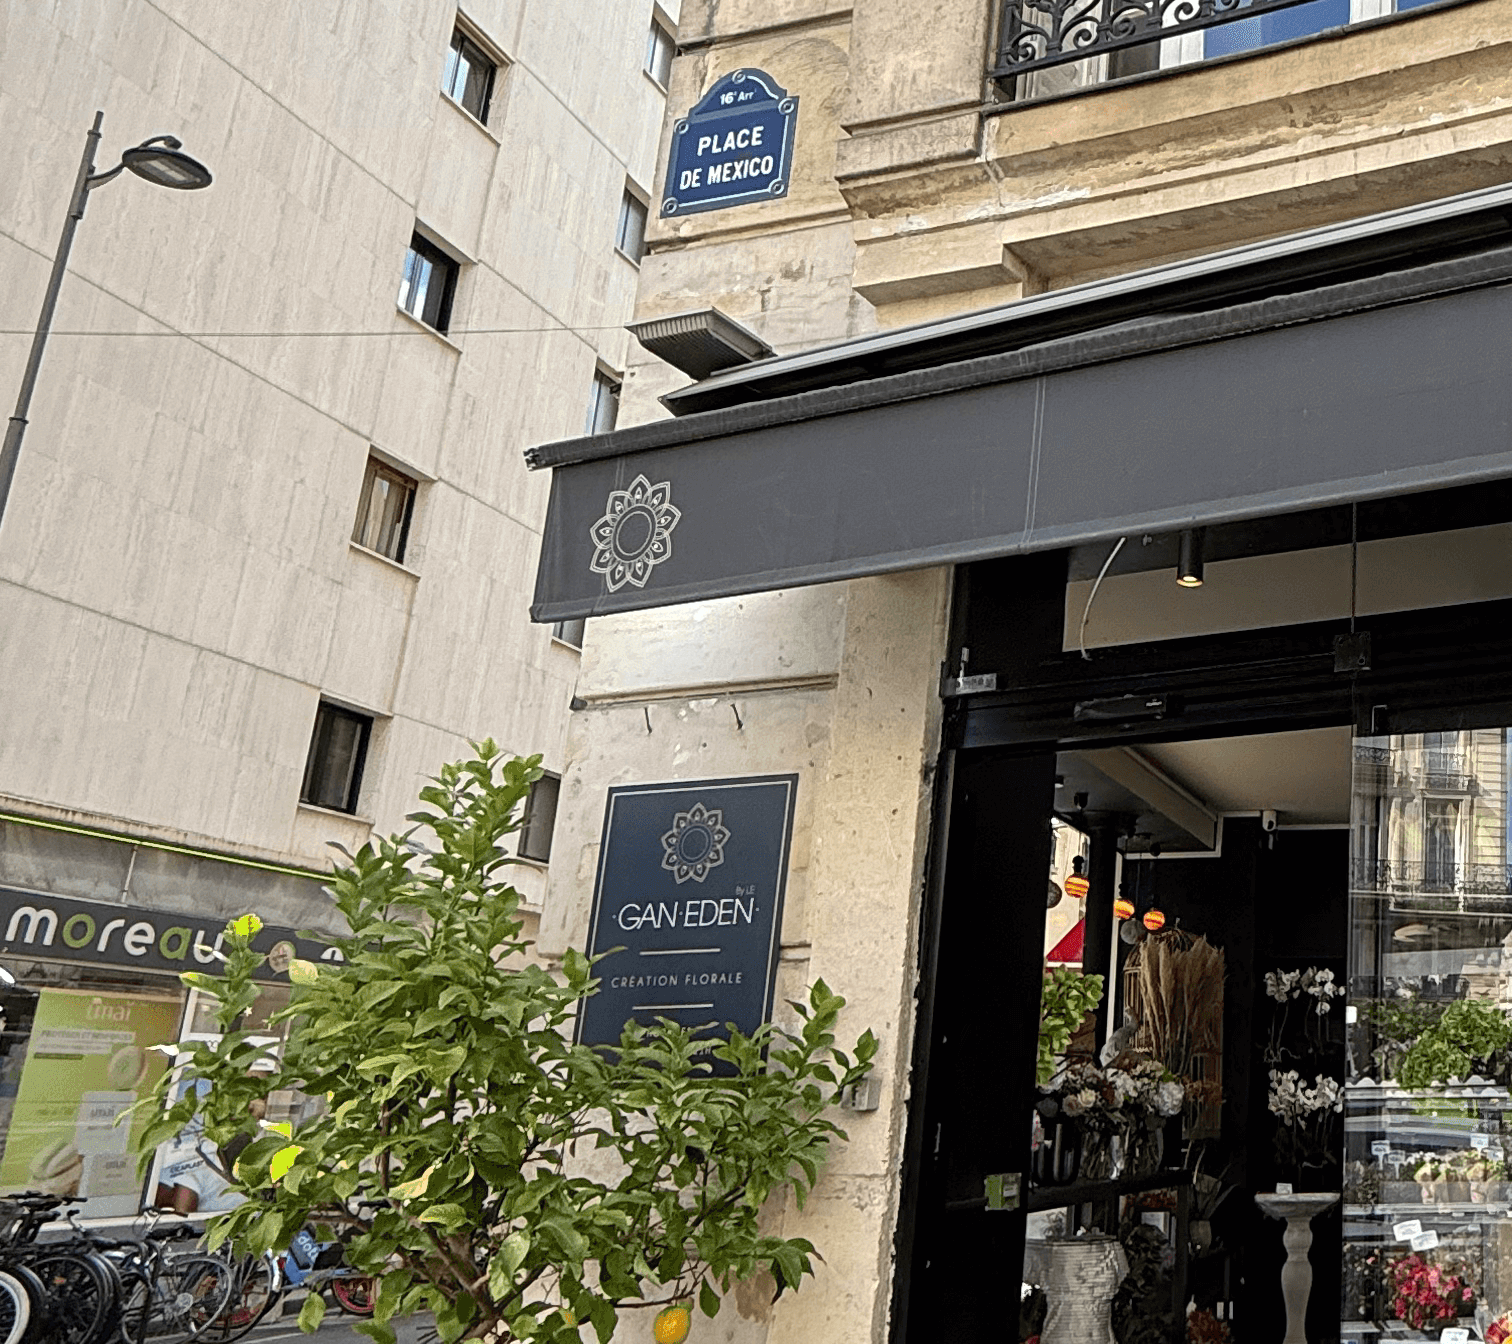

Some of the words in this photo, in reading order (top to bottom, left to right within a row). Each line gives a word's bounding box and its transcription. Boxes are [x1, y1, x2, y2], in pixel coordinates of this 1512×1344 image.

[697, 125, 765, 157] PLACE
[679, 167, 702, 190] DE
[707, 155, 774, 185] MEXICO
[5, 906, 224, 964] moreau
[611, 973, 678, 989] CRÉATION
[684, 971, 743, 987] FLORALE
